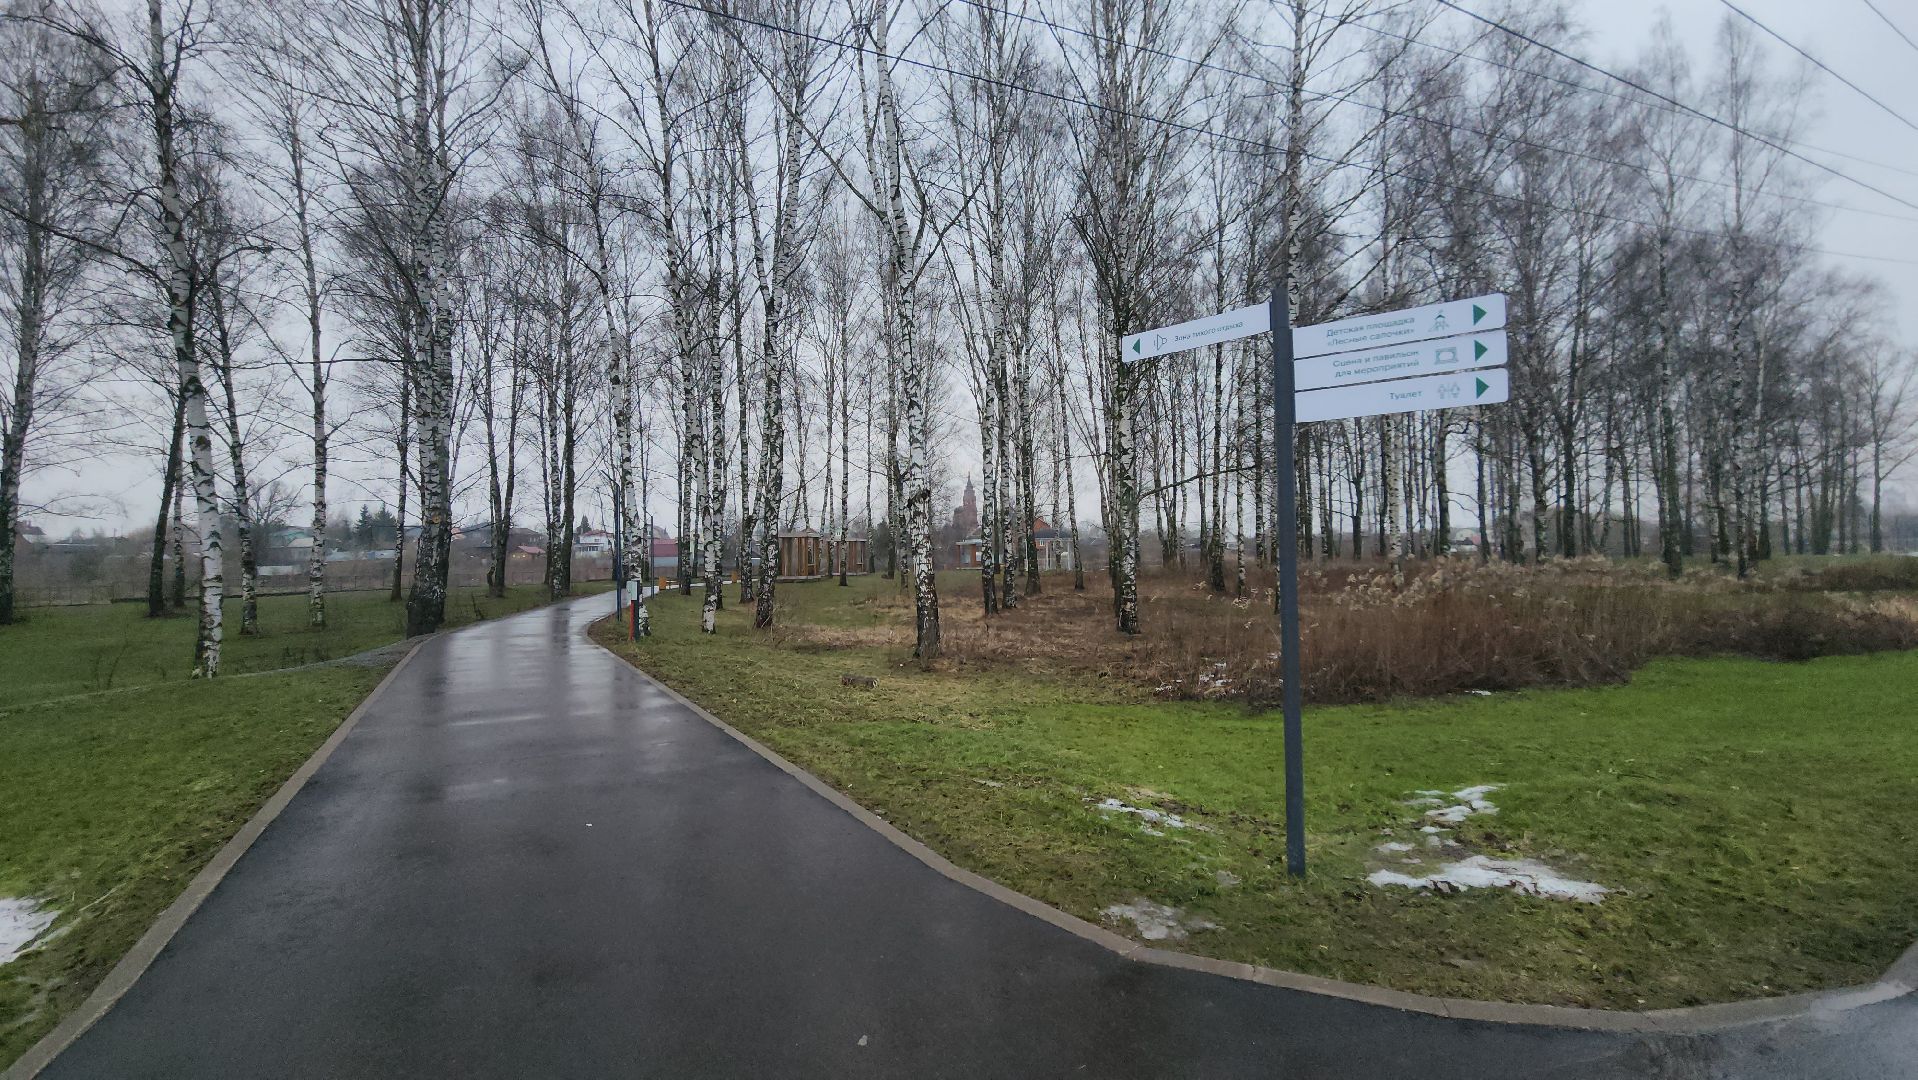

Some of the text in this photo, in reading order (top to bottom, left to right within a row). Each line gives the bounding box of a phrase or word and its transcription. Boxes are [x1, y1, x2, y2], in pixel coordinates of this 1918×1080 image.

[1192, 328, 1216, 338] тихого
[1217, 321, 1244, 332] отдыха
[1327, 317, 1415, 338] Детская площадка
[1333, 358, 1362, 367] Сцена
[1373, 351, 1420, 362] павильон
[1335, 359, 1420, 378] для мероприятий
[1389, 391, 1423, 400] Туалет
